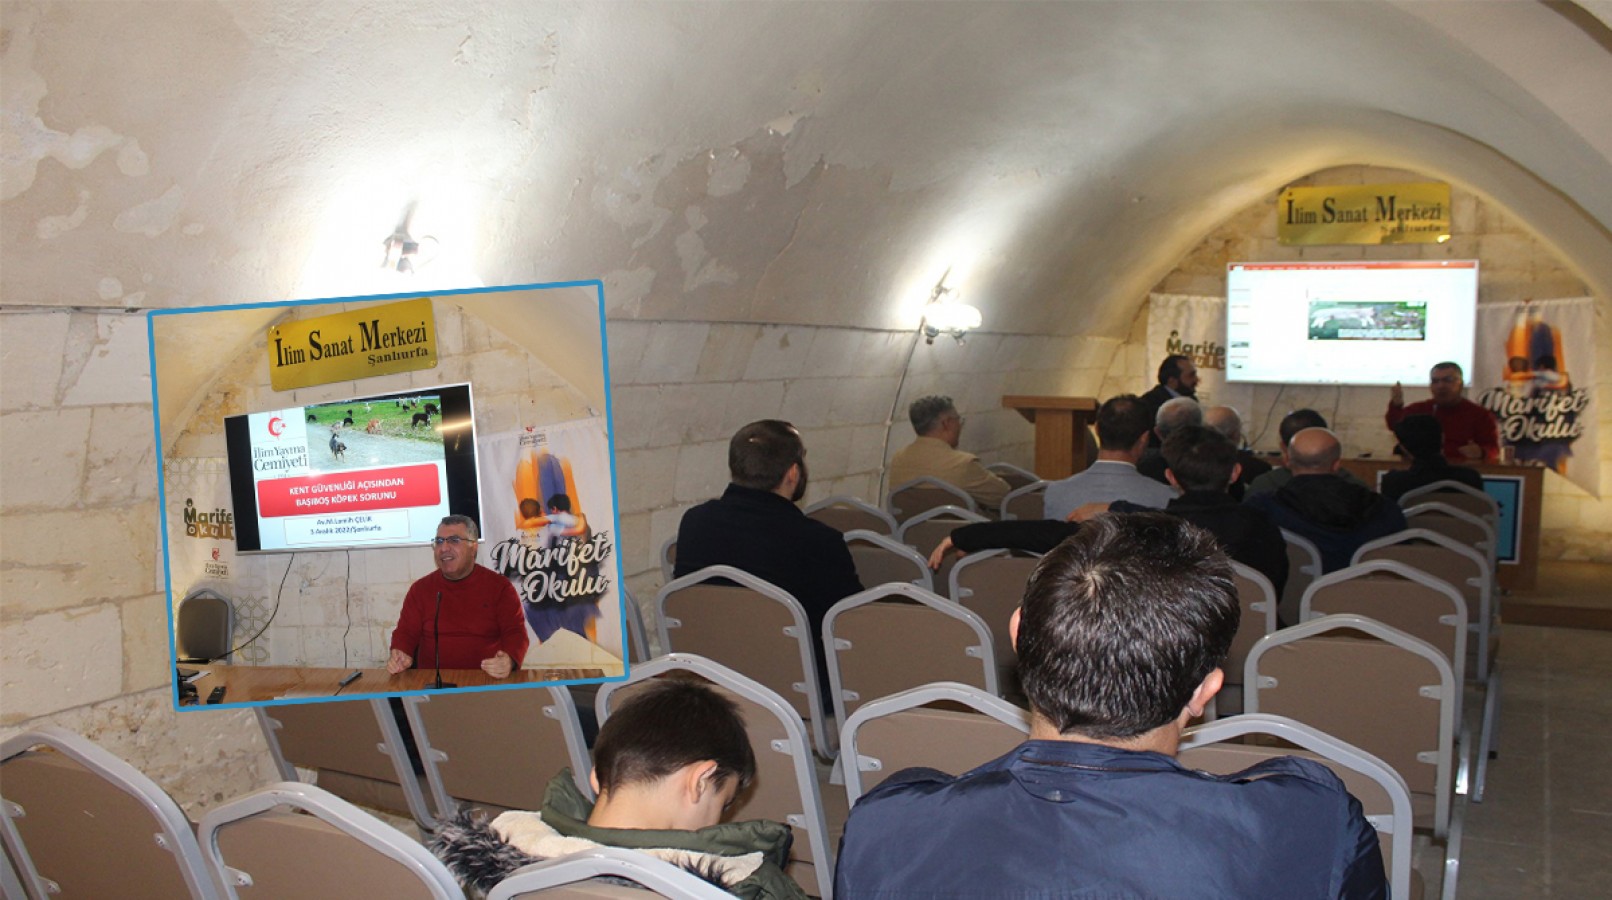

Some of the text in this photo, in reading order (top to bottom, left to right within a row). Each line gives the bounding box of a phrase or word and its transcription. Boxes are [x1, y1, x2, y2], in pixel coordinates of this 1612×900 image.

[1286, 192, 1442, 225] İlim Sanat Merkezi
[274, 319, 428, 367] İlim Sanat Merkezi
[367, 346, 428, 367] Şanlıurfa
[1479, 388, 1589, 423] Marifet
[1502, 415, 1583, 442] Okulu
[254, 454, 308, 474] Cemiyeti
[289, 478, 404, 495] KENT GÜVENLİĞİ AÇISINDAN
[296, 491, 397, 507] BAŞIBOŞ KÖPEK SORUNU
[491, 532, 612, 576] Marifet
[522, 567, 609, 603] Okulu
